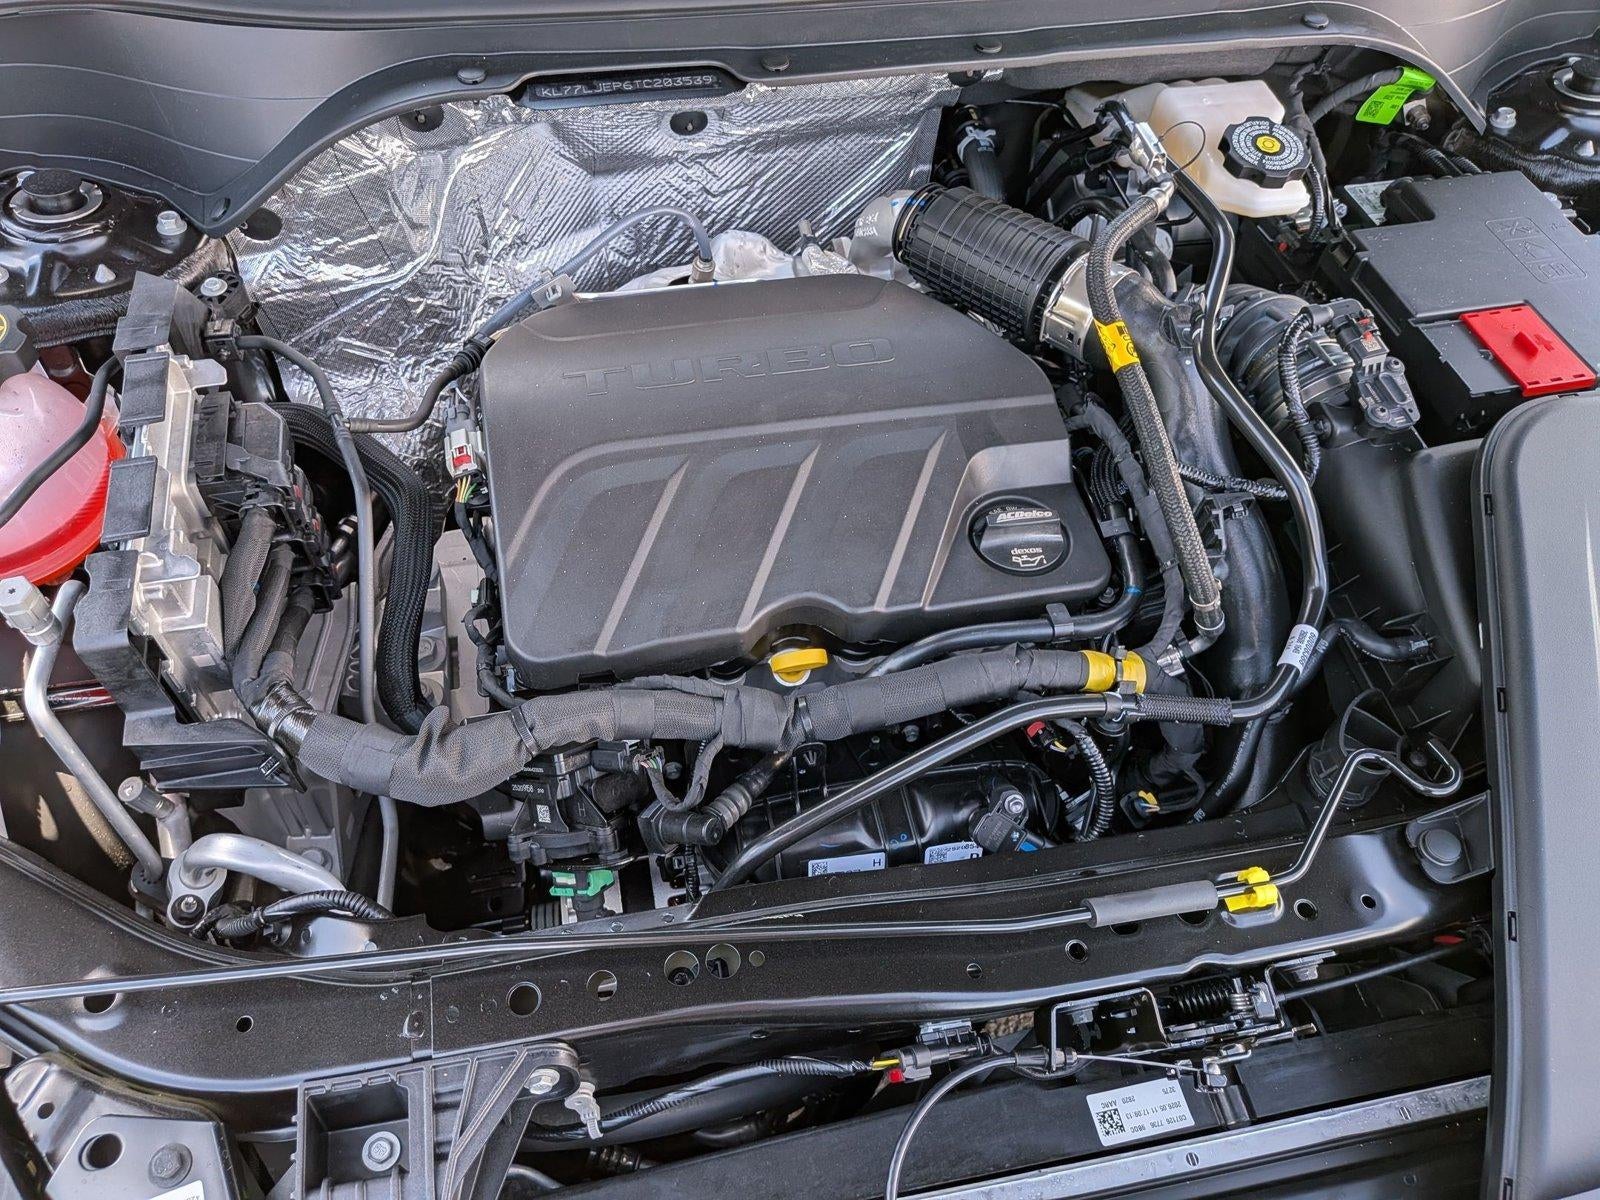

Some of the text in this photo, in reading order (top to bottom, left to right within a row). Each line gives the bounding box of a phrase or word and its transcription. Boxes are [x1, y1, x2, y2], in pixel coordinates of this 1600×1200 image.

[562, 337, 897, 397] TURBO
[997, 510, 1052, 523] ACDelco
[1011, 547, 1042, 555] dexos
[872, 858, 882, 867] H
